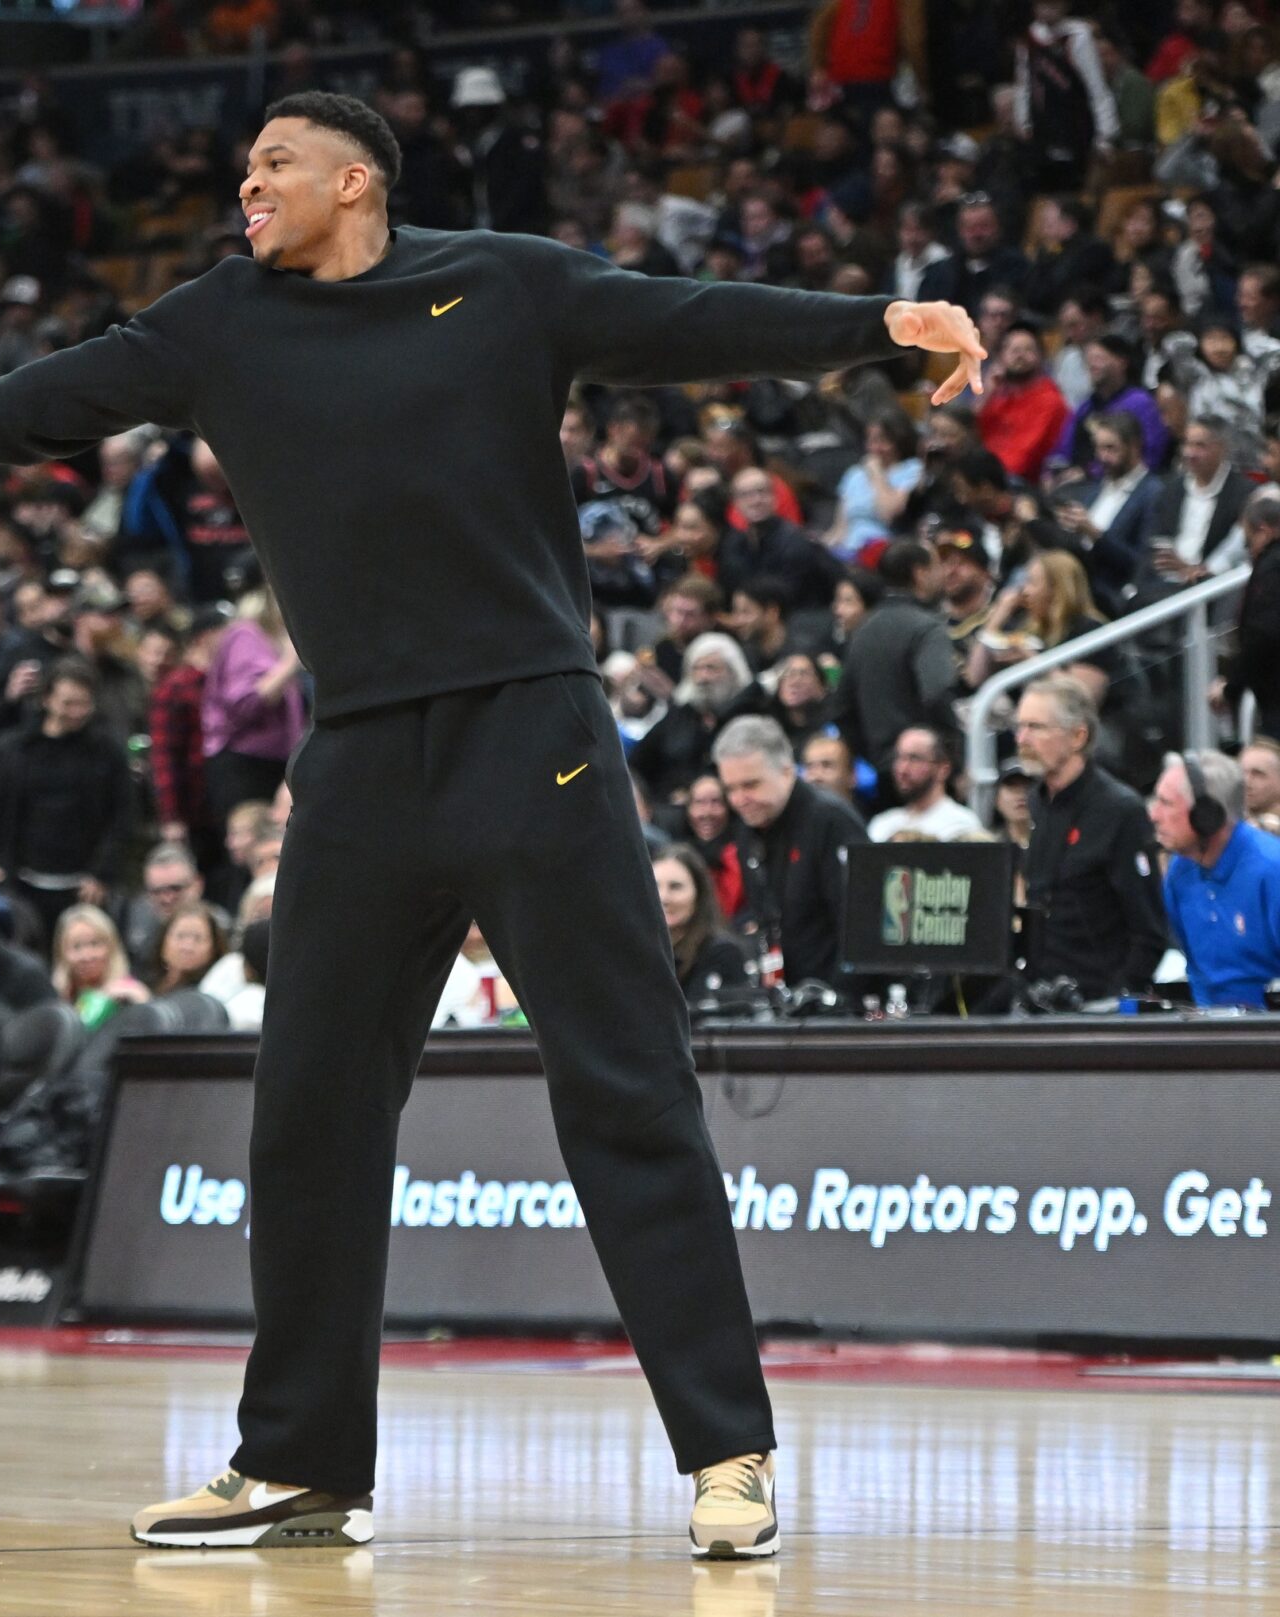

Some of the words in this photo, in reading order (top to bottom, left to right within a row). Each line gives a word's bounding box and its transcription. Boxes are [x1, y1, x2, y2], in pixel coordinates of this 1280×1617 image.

[914, 866, 971, 916] Replay
[911, 909, 968, 946] Center
[160, 1164, 246, 1225] Use
[390, 1165, 587, 1228] asterca
[806, 1167, 1020, 1248] Raptors
[1028, 1185, 1148, 1252] app.
[1163, 1168, 1272, 1237] Get
